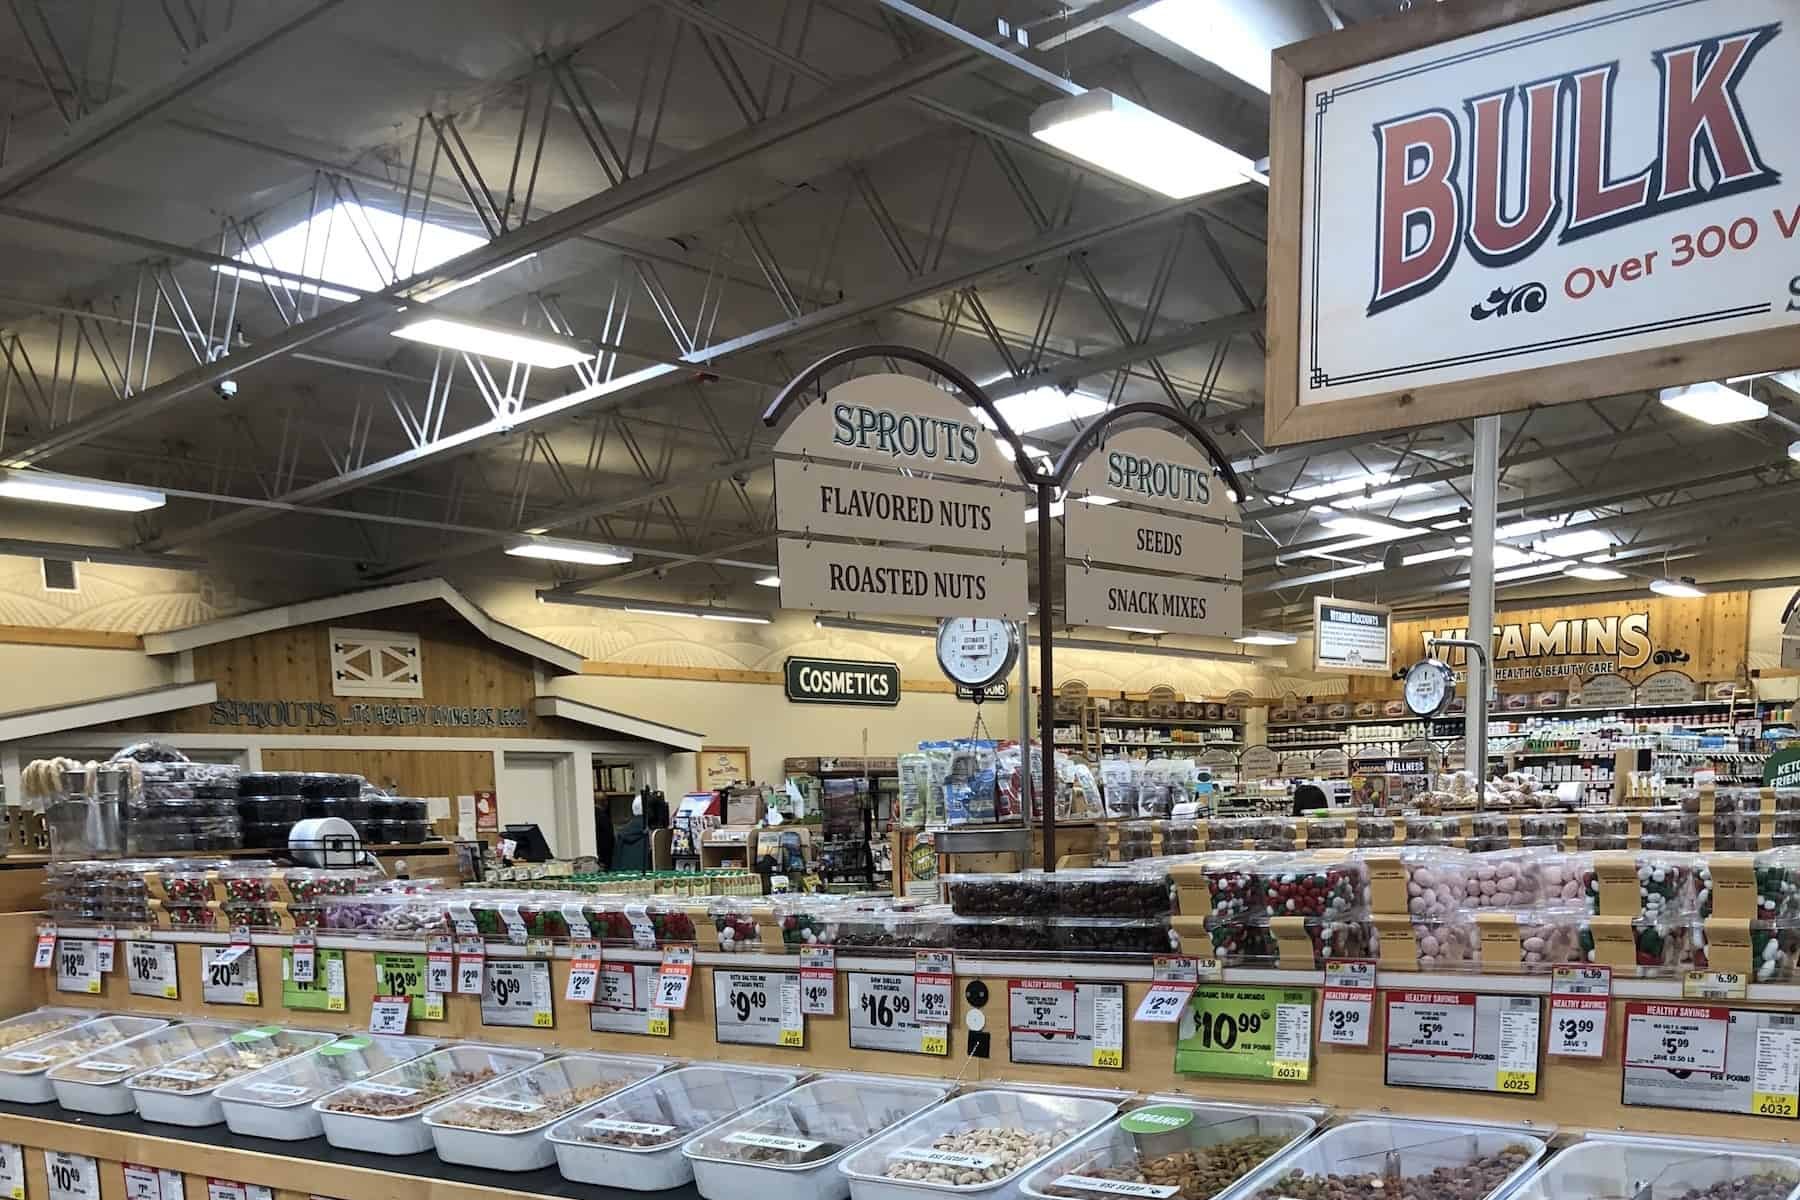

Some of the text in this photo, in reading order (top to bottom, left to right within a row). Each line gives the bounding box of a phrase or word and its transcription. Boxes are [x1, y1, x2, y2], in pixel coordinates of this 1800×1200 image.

[1367, 21, 1782, 317] BULK
[1564, 249, 1658, 299] Over
[1671, 216, 1758, 267] 300
[833, 402, 979, 464] SPROUTS
[1107, 451, 1210, 505] SPROUTS
[820, 485, 991, 531] FLAVORED NUTS
[1137, 527, 1183, 556] SEEDS
[829, 562, 986, 600] ROASTED NUTS
[1108, 588, 1207, 619] SNACK MIXES
[799, 666, 889, 696] COSMETICS
[1495, 662, 1613, 681] HEALTH & BEAUTY CARE
[208, 699, 336, 727] SPROUTS
[1404, 993, 1459, 1004] HEALTHY SAVINGS
[1553, 999, 1606, 1009] HEALTHY SAVINGS
[1647, 1005, 1710, 1018] HEALTHY SAVINGS
[1277, 1068, 1300, 1078] 6031
[1503, 1079, 1530, 1090] 6025
[1726, 1074, 1750, 1082] POUND
[1760, 1103, 1791, 1115] 6032
